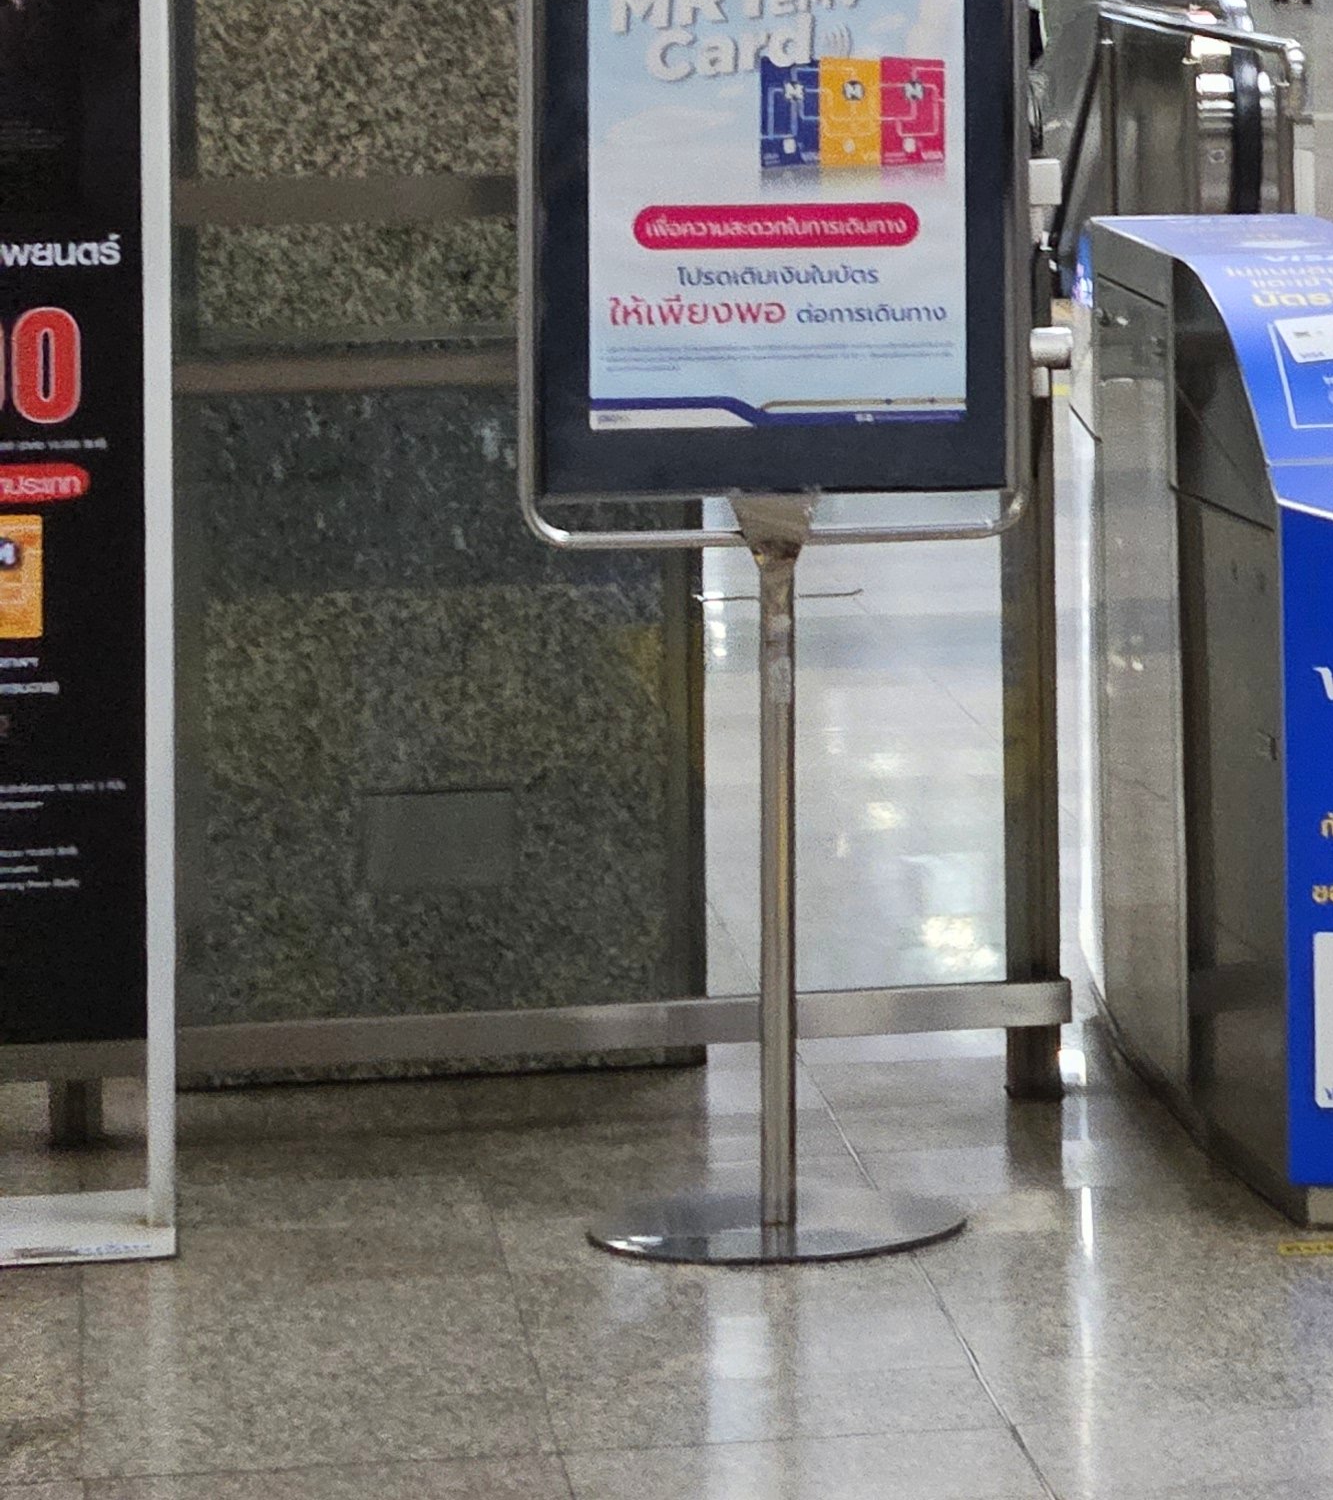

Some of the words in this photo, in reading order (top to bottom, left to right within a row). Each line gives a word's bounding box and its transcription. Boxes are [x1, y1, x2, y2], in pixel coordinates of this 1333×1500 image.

[647, 10, 817, 82] Card
[609, 293, 787, 327] ให้เพียงพอ
[796, 303, 948, 325] ต่อการเดินทาง
[0, 306, 82, 424] 0
